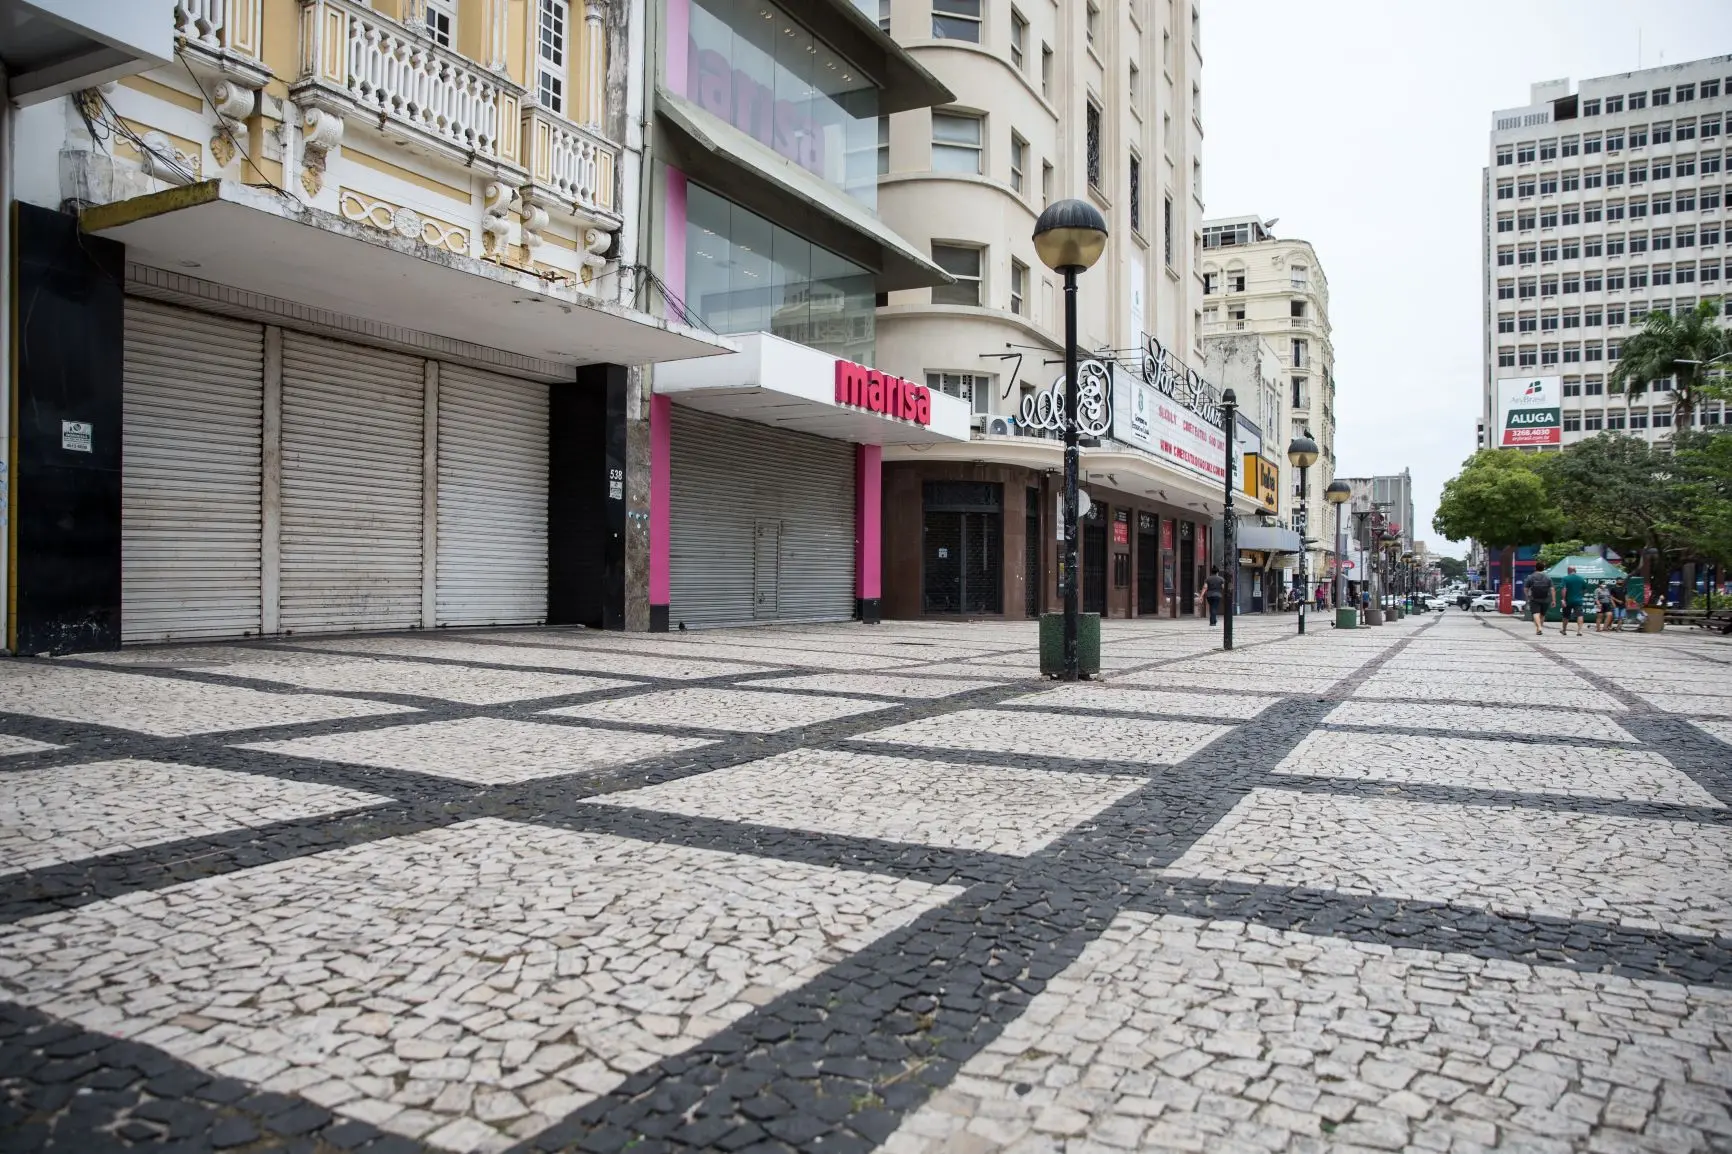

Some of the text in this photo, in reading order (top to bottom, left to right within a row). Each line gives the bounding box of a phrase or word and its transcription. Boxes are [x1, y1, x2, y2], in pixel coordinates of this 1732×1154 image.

[835, 359, 931, 425] marisa
[1187, 369, 1222, 427] Luiz
[1511, 412, 1554, 423] ALUGA
[610, 469, 623, 480] 538
